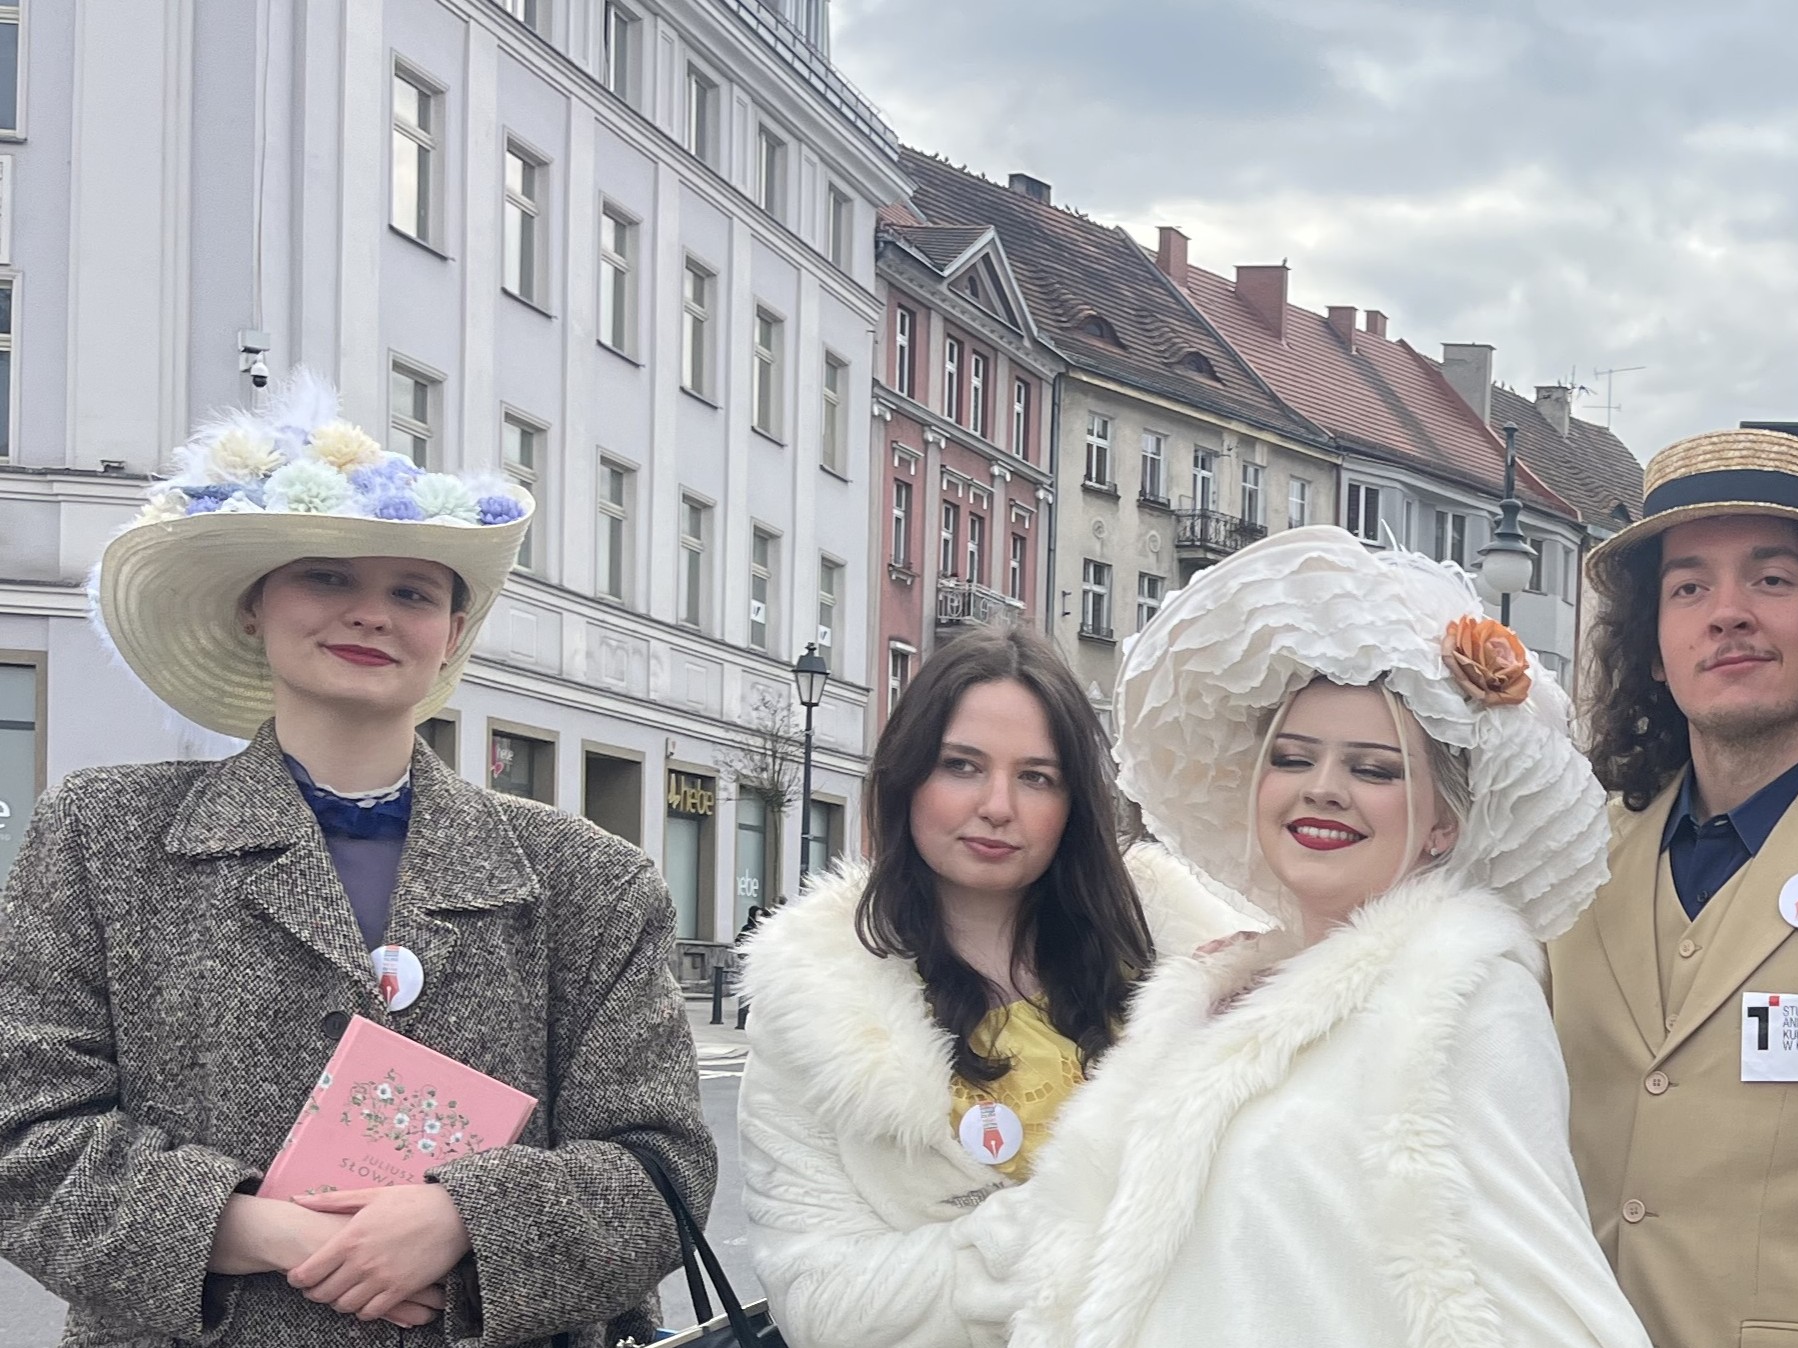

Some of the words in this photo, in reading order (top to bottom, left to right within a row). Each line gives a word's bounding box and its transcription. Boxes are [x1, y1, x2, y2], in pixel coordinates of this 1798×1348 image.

[680, 775, 714, 815] hebe
[1783, 1040, 1793, 1051] W
[363, 1155, 414, 1182] JULIUSZ
